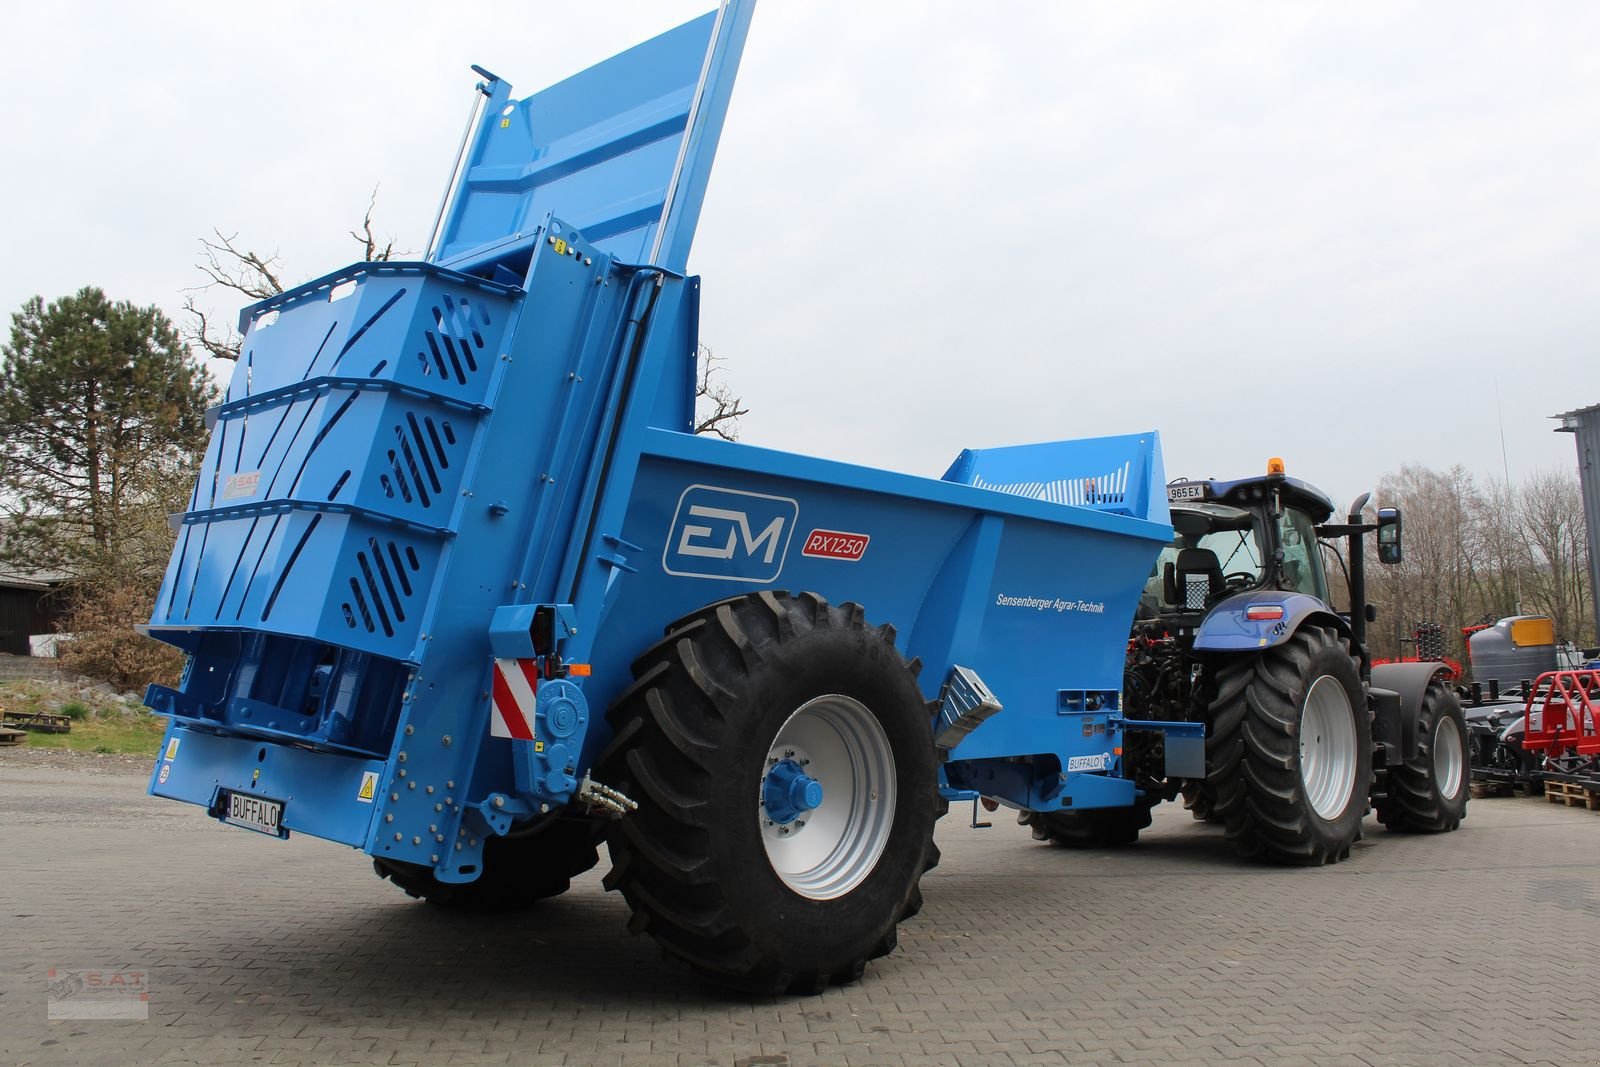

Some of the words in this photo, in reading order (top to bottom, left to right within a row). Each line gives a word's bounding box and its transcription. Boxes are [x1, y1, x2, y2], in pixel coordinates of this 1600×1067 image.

[1171, 488, 1188, 498] 965
[1188, 487, 1200, 497] EX
[677, 505, 785, 563] EM
[996, 593, 1053, 611] Sensenberger
[1053, 598, 1104, 613] Agrar-Technik
[1069, 757, 1100, 769] BUFFALO
[233, 796, 277, 827] BUFFALO
